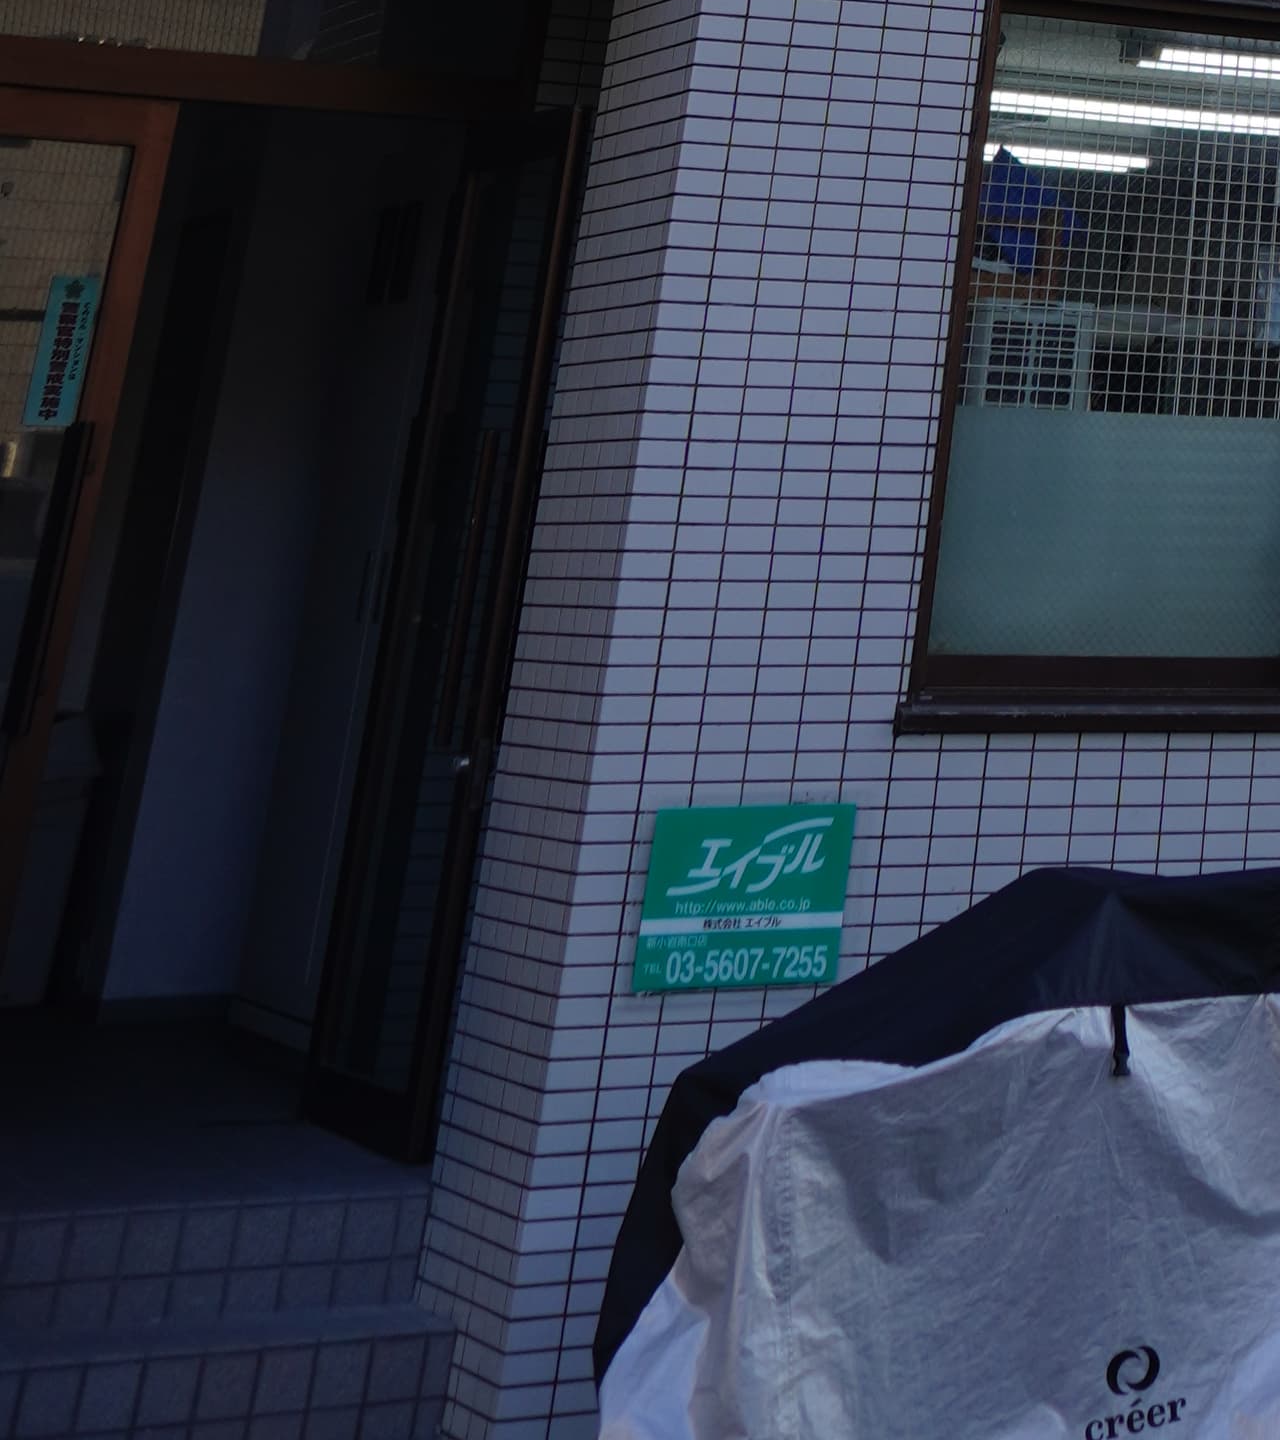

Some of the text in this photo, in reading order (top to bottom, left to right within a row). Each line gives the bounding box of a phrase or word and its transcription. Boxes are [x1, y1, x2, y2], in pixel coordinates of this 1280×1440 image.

[667, 817, 834, 896] エイブル
[674, 897, 812, 916] http://www.able.co.jp
[666, 944, 828, 984] 03-5607-7255
[1085, 1397, 1187, 1440] créer
